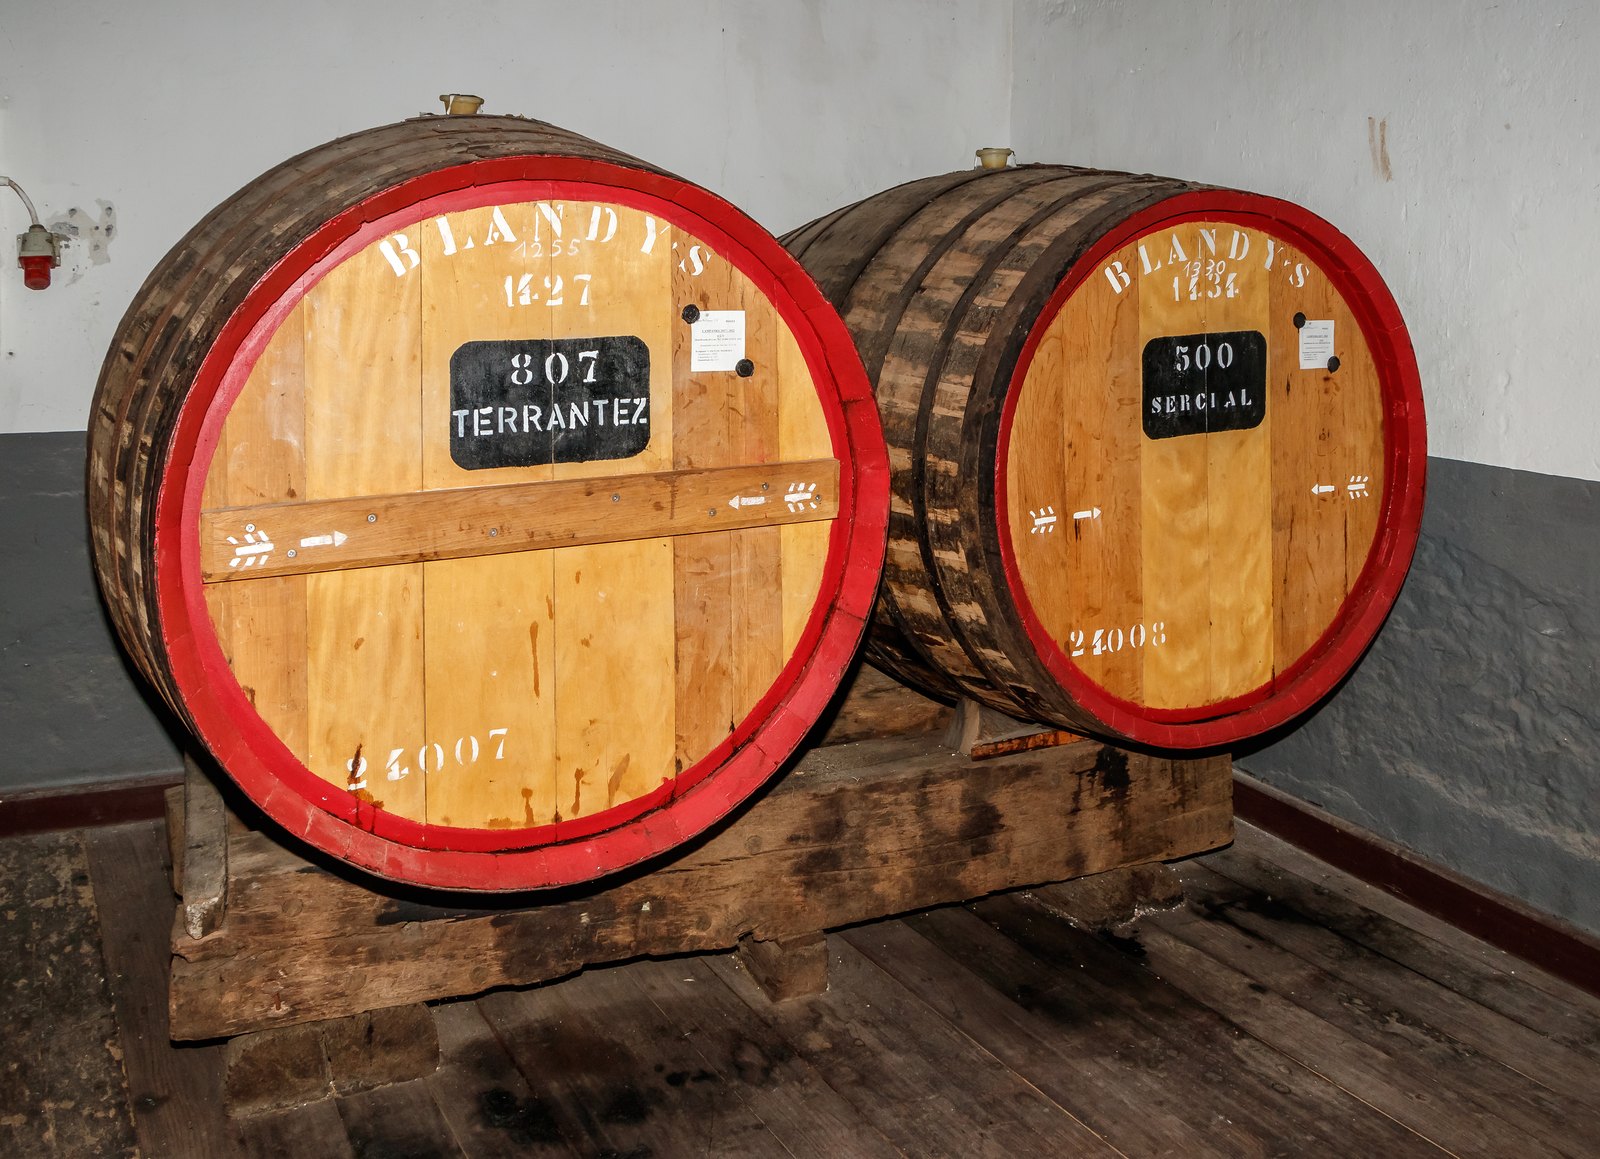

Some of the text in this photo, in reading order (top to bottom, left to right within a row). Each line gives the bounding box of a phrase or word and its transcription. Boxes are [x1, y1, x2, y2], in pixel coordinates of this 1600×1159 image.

[379, 202, 711, 277] BLANDY'S
[512, 238, 581, 258] 1255
[1104, 228, 1310, 295] BLANDY'S
[1183, 258, 1226, 278] 1330
[504, 272, 592, 308] 1427
[1173, 272, 1240, 302] 1434
[510, 349, 600, 386] 807
[1175, 342, 1234, 372] 500
[452, 397, 648, 438] TERRANTEZ
[1070, 621, 1166, 657] 24008
[346, 727, 509, 791] 24007
